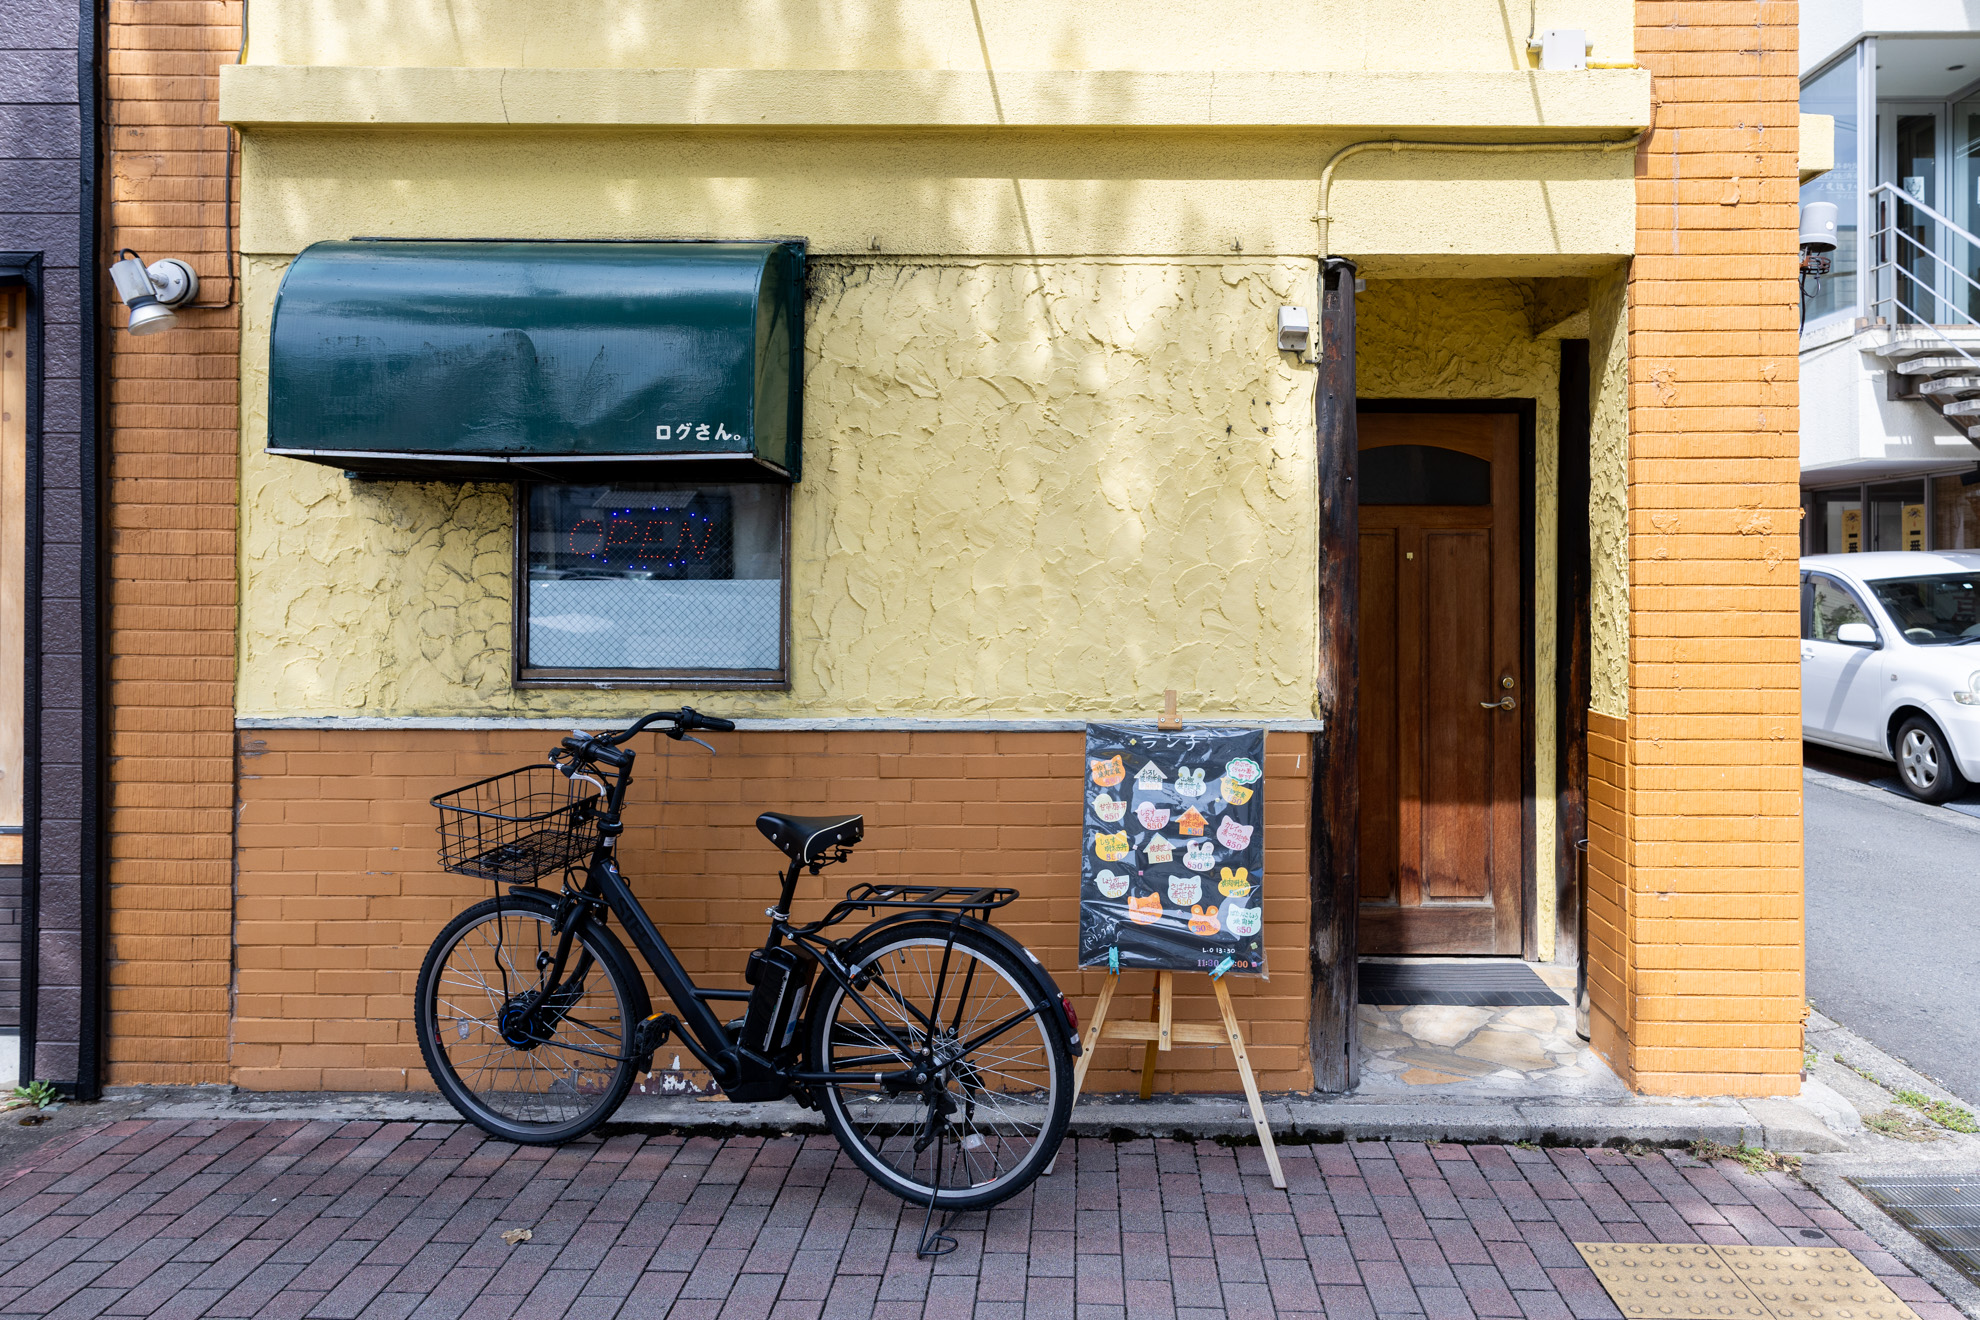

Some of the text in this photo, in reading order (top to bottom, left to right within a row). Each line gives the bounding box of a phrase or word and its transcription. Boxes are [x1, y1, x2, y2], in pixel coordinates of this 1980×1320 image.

[656, 422, 741, 441] ログさん。
[570, 519, 713, 560] OPEN
[1142, 734, 1200, 751] ランチ
[1105, 776, 1121, 785] 880
[1104, 813, 1120, 821] 850
[1140, 809, 1155, 817] しらす
[1146, 822, 1163, 830] 850
[1226, 822, 1243, 833] カレイの
[1187, 828, 1203, 836] 850
[1100, 836, 1115, 845] しらす
[1225, 840, 1242, 850] 850
[1106, 853, 1122, 861] 850
[1155, 854, 1171, 862] 880
[1187, 861, 1203, 870] 850
[1171, 883, 1197, 891] さばみそ
[1107, 890, 1122, 898] 850
[1177, 898, 1192, 906] 850
[1191, 925, 1206, 933] 850
[1236, 926, 1252, 934] 850
[1197, 959, 1219, 967] 11:30
